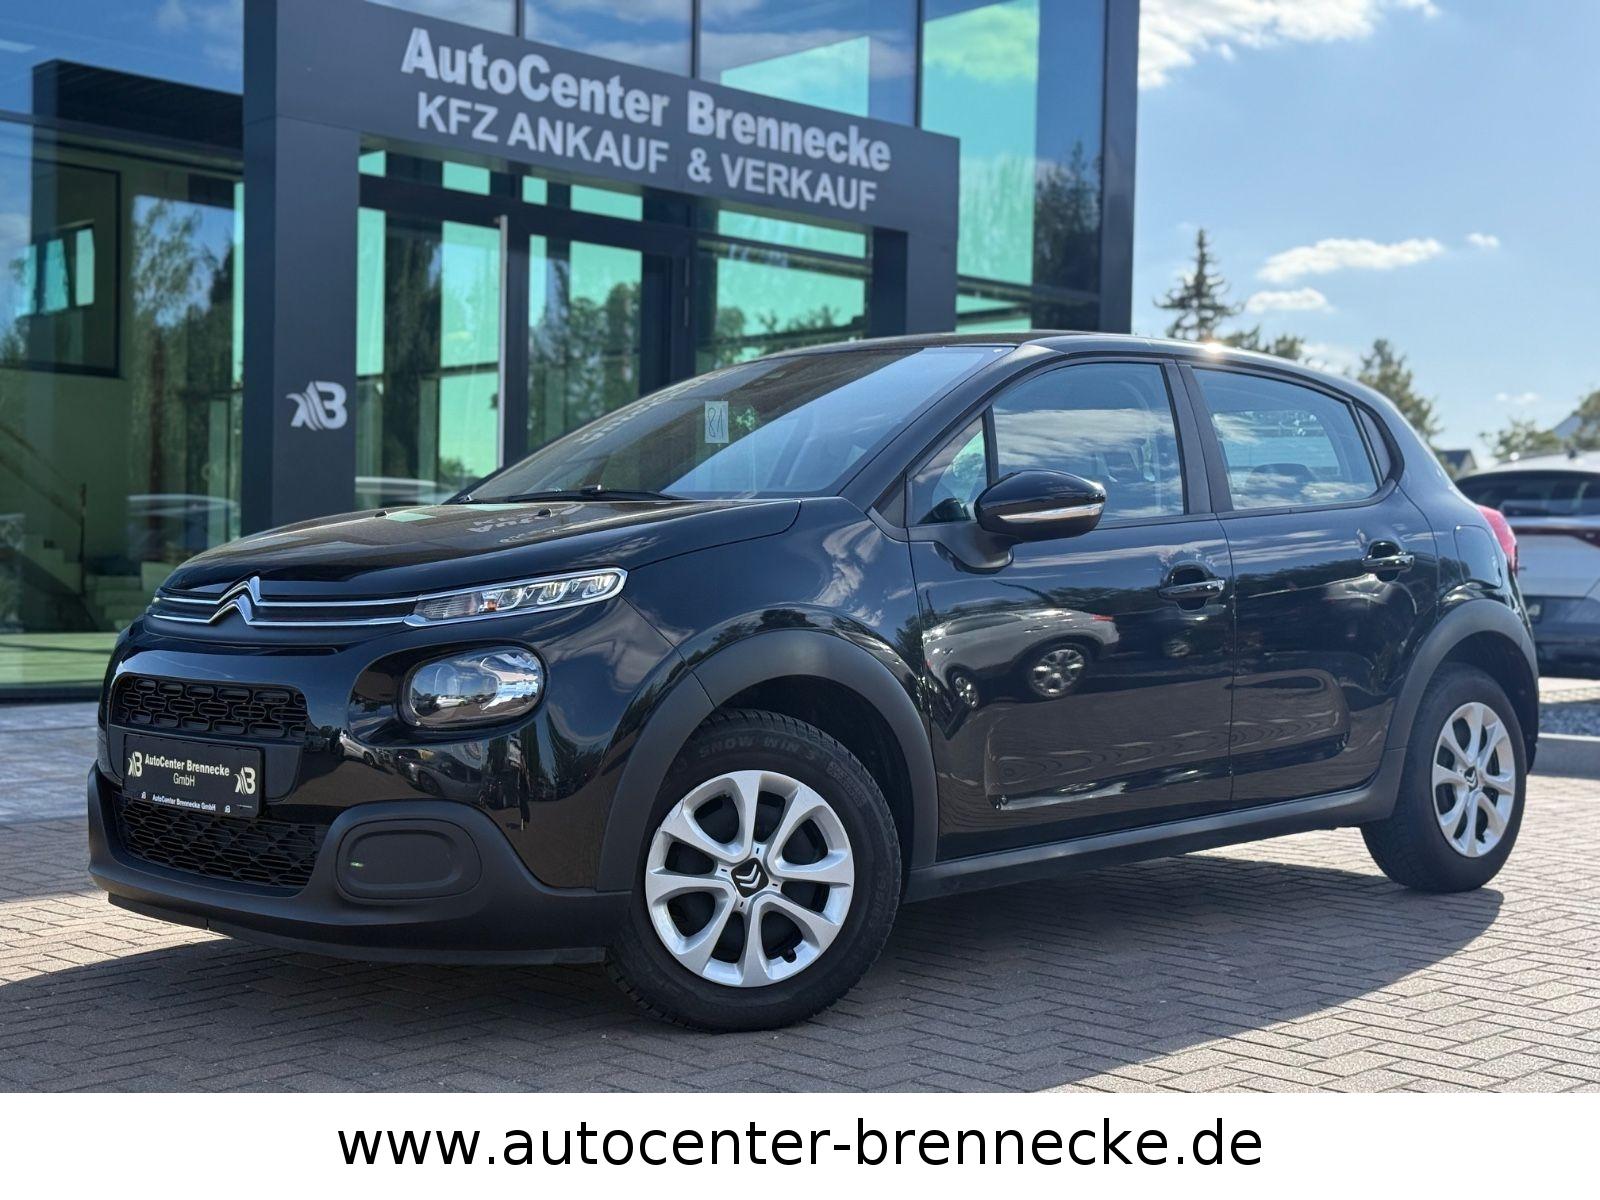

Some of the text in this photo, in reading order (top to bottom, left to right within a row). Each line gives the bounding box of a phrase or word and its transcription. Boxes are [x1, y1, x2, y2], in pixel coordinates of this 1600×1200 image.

[401, 27, 892, 172] AutoCenter Brennecke
[417, 91, 879, 212] KFZ ANKAUF & VERKAUF
[145, 753, 230, 776] AutoCenter Brennecke
[173, 772, 196, 787] GmbH
[200, 802, 217, 811] GmbH
